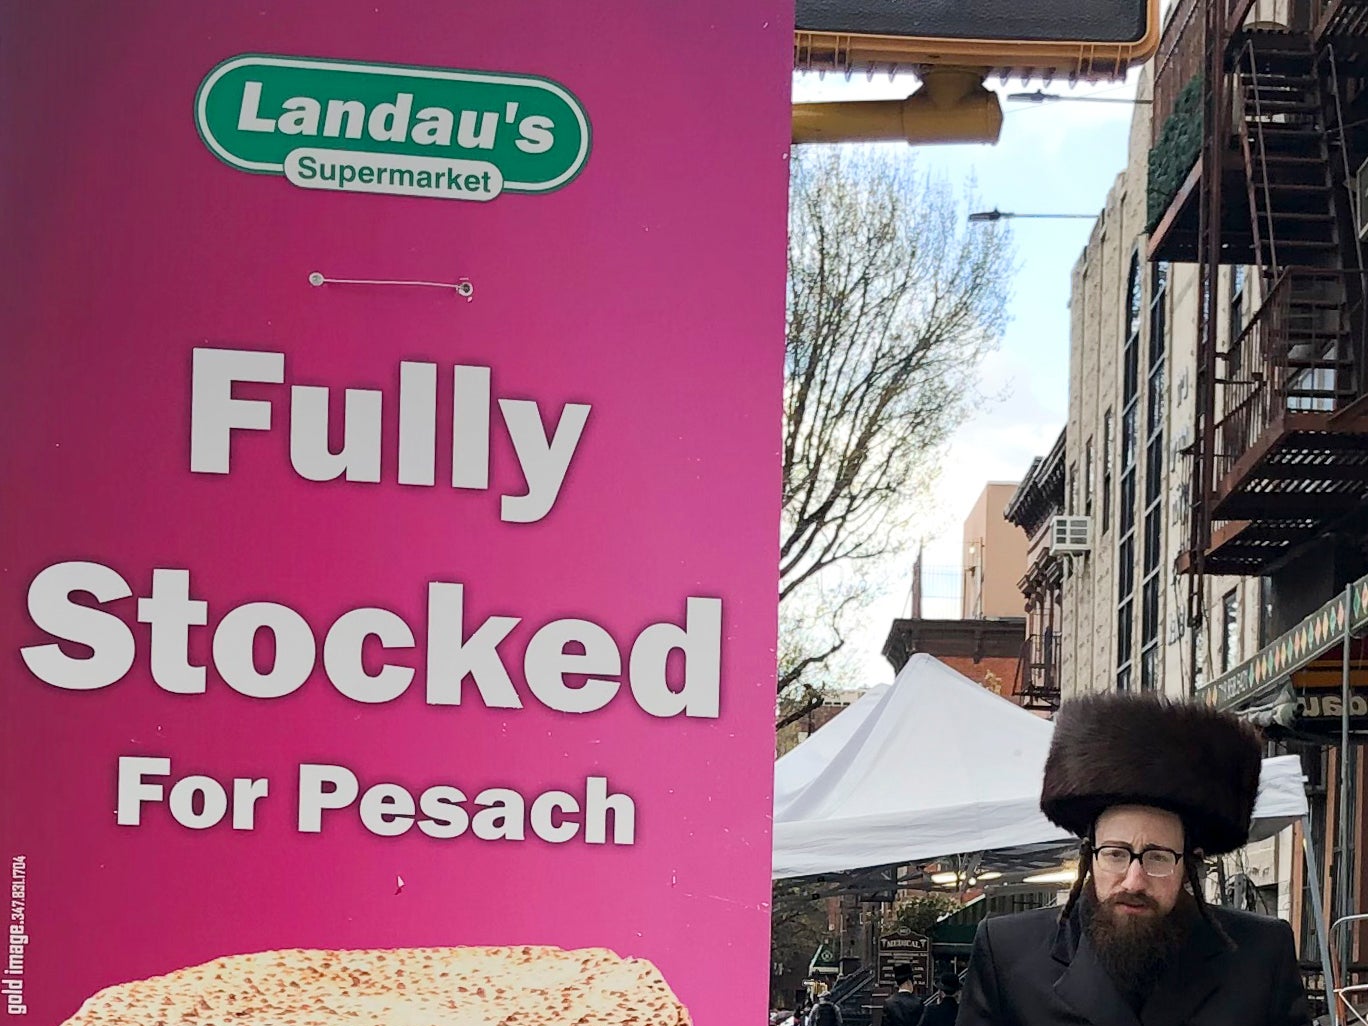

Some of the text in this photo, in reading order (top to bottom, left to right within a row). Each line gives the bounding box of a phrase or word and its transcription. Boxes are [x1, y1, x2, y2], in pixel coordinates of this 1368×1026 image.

[237, 81, 557, 155] Landau's
[296, 154, 493, 195] Supermarket
[190, 346, 593, 525] Fully
[20, 559, 723, 720] Stocked
[116, 755, 637, 847] For Pesach
[1, 979, 28, 1015] gold
